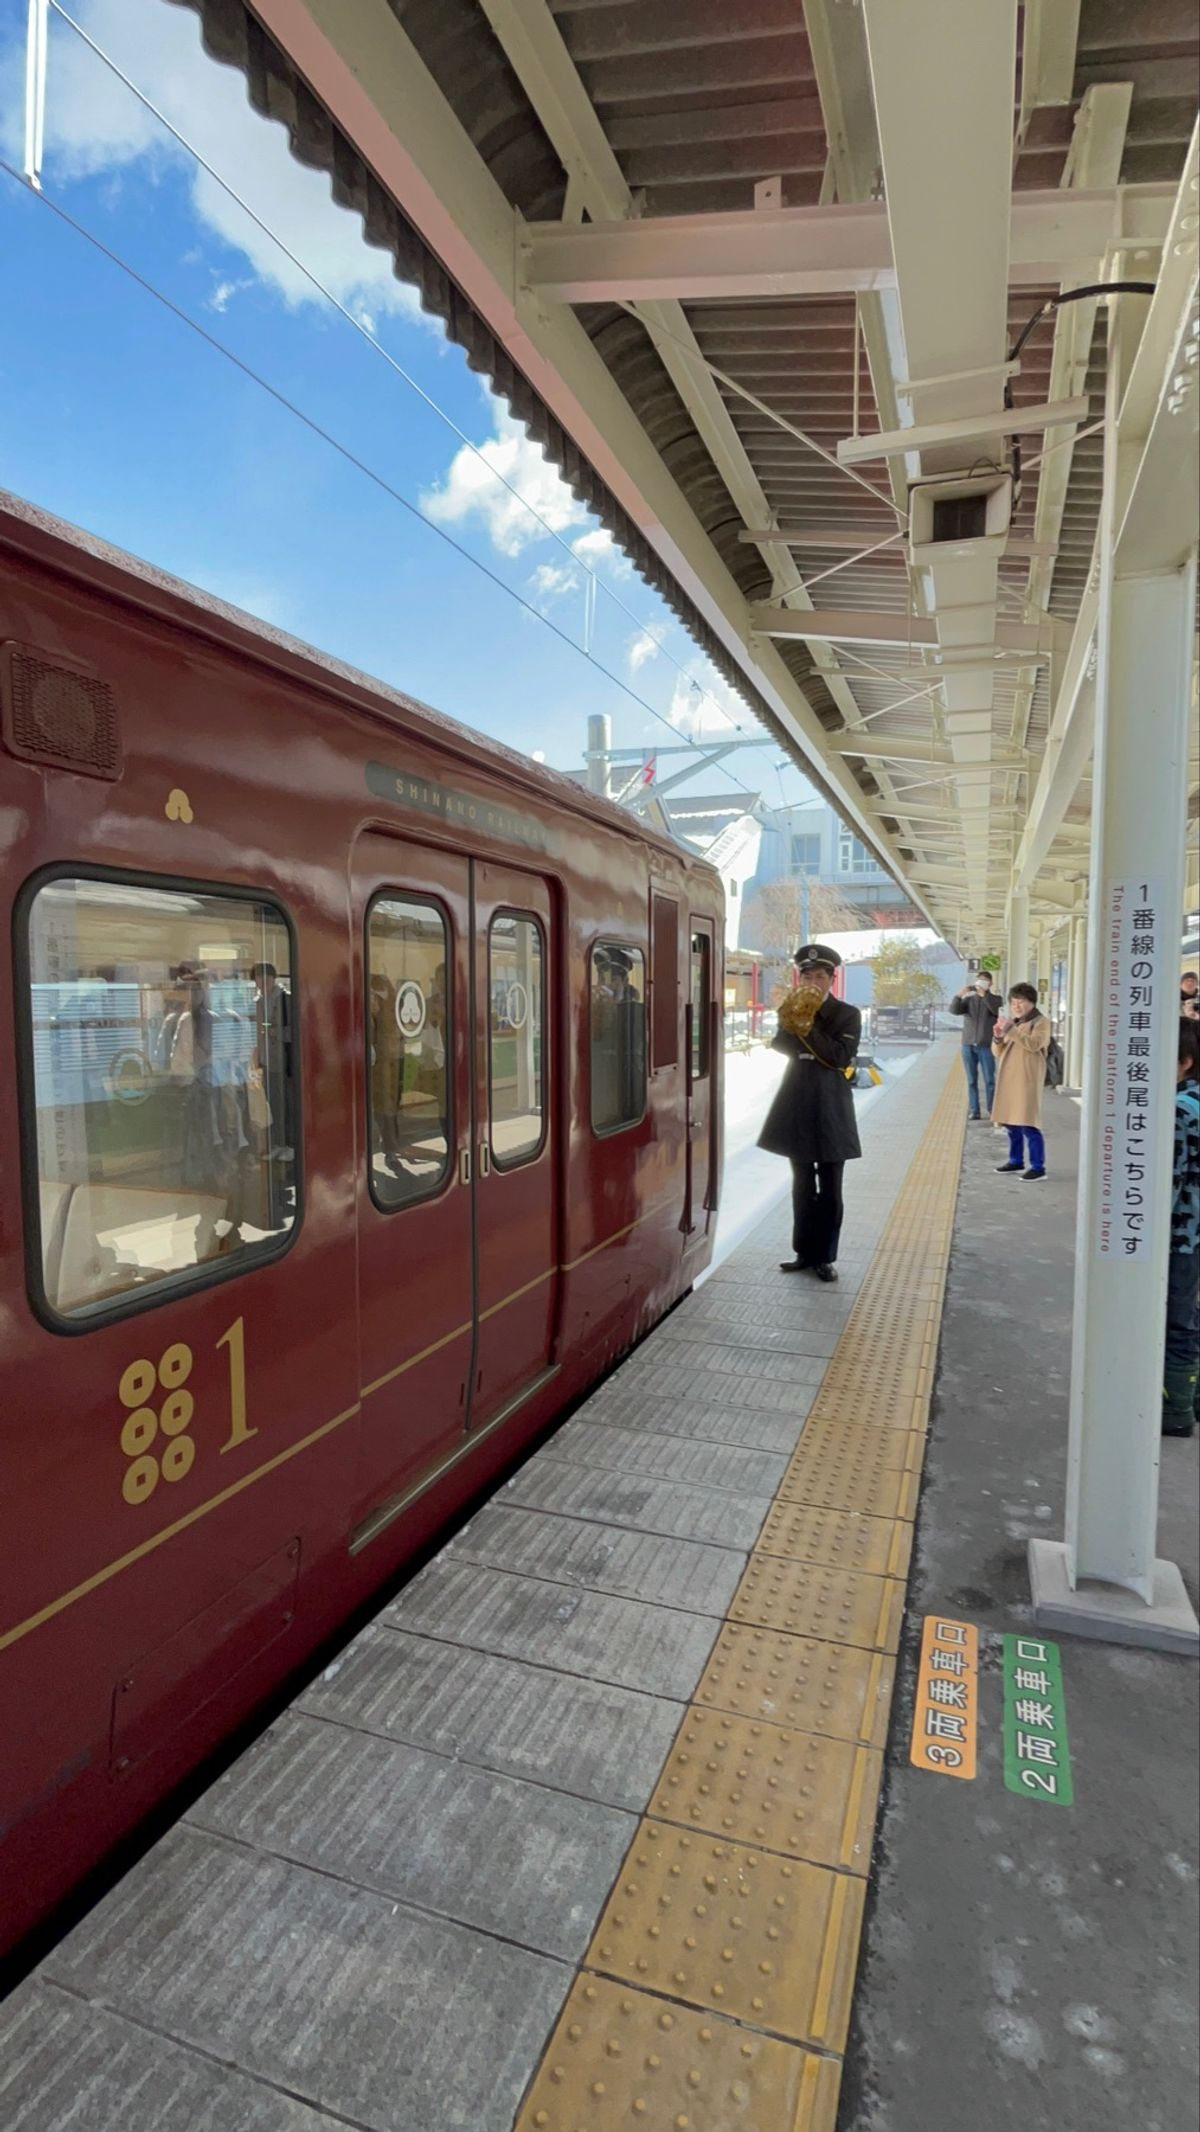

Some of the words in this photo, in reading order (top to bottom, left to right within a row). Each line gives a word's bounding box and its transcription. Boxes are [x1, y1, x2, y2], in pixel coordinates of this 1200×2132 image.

[395, 778, 477, 820] SHINANO
[1112, 886, 1124, 912] The
[1111, 919, 1123, 953] train
[1109, 993, 1120, 1007] of
[1107, 1014, 1119, 1037] the
[1106, 1043, 1118, 1105] platform
[1121, 884, 1156, 1255] 1番線の列車最後尾はこちらです
[1102, 1125, 1116, 1197] departure
[1102, 1203, 1114, 1214] is
[1101, 1221, 1113, 1252] here
[215, 1315, 258, 1455] 1
[926, 1621, 968, 1767] 3両乗車口
[1014, 1640, 1059, 1795] 2両乗車口
